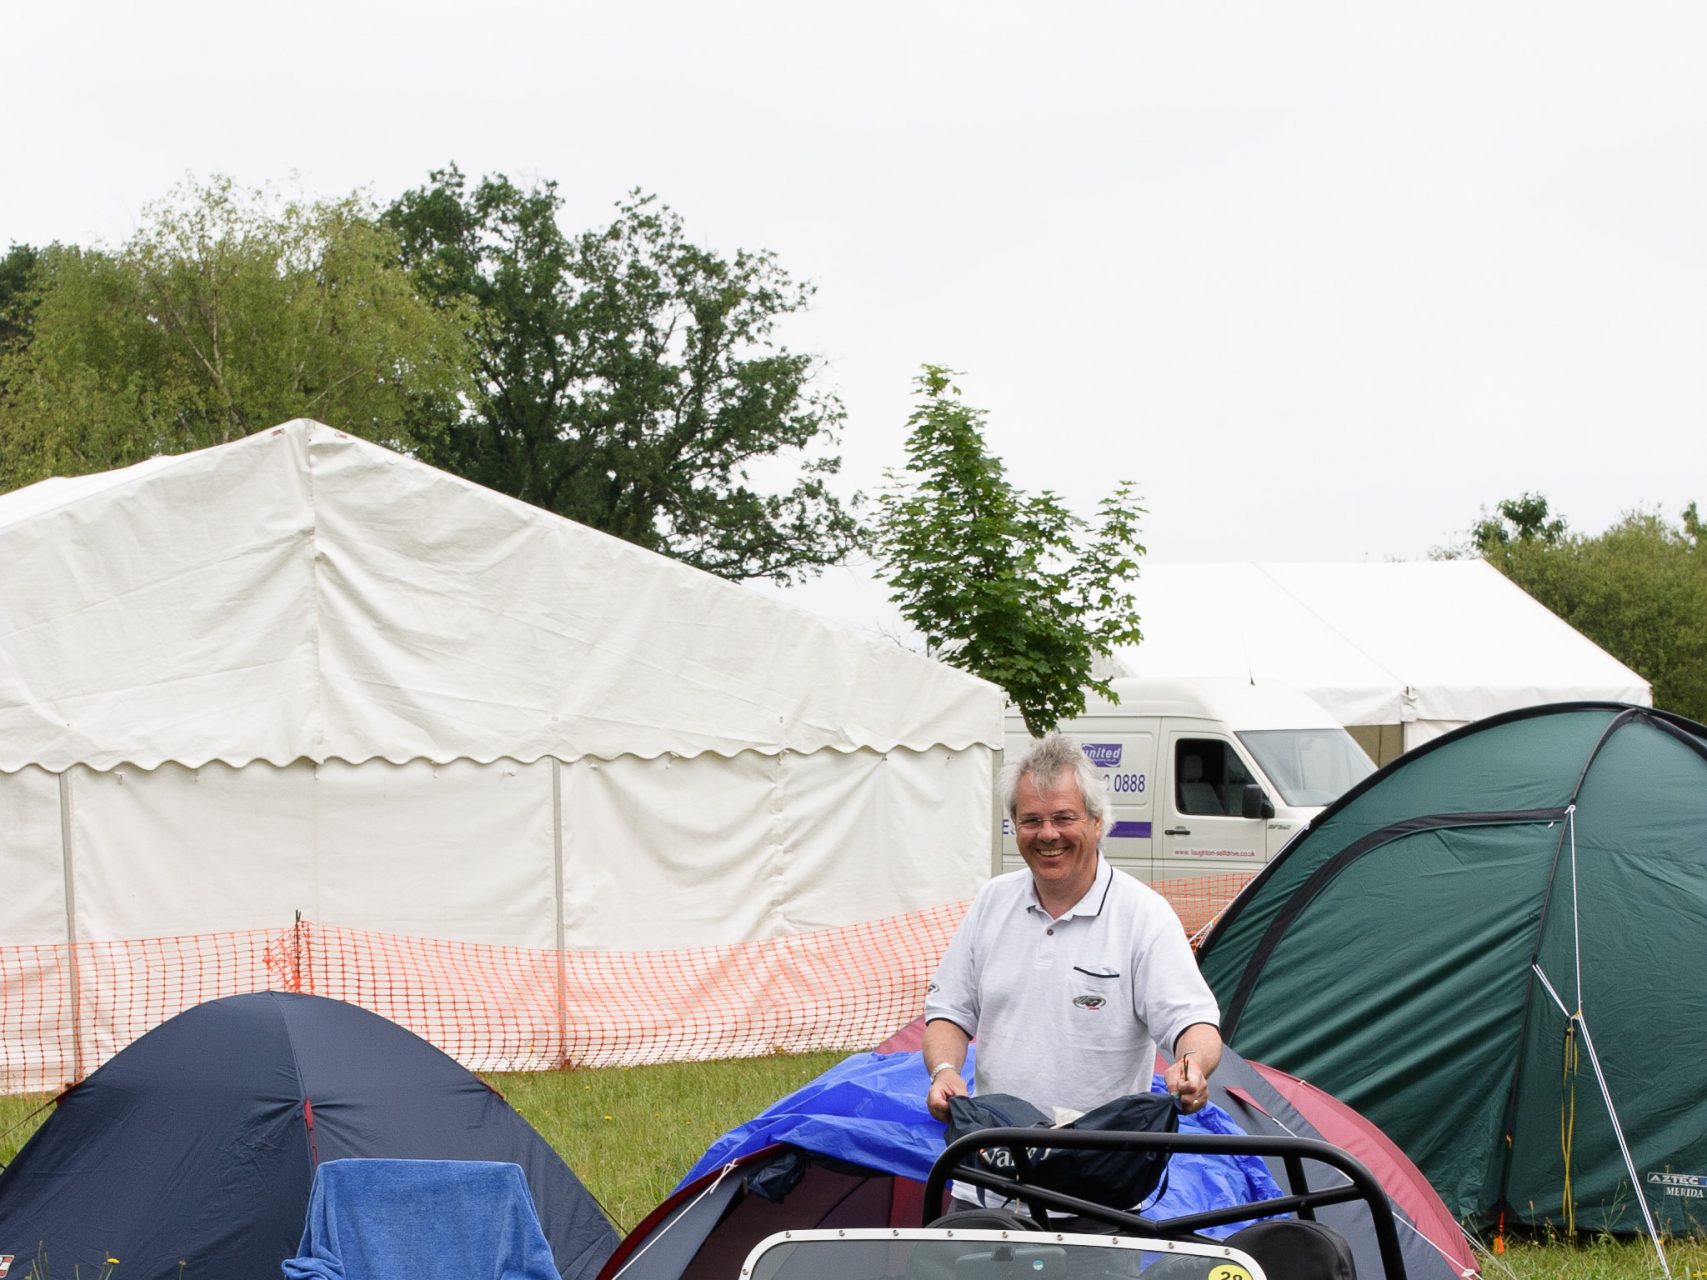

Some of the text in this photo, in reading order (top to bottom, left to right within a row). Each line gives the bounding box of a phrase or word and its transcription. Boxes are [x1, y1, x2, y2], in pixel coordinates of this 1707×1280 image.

[1114, 774, 1146, 792] 0888
[1650, 1174, 1699, 1185] AZTEC
[1665, 1187, 1704, 1198] MERIDA
